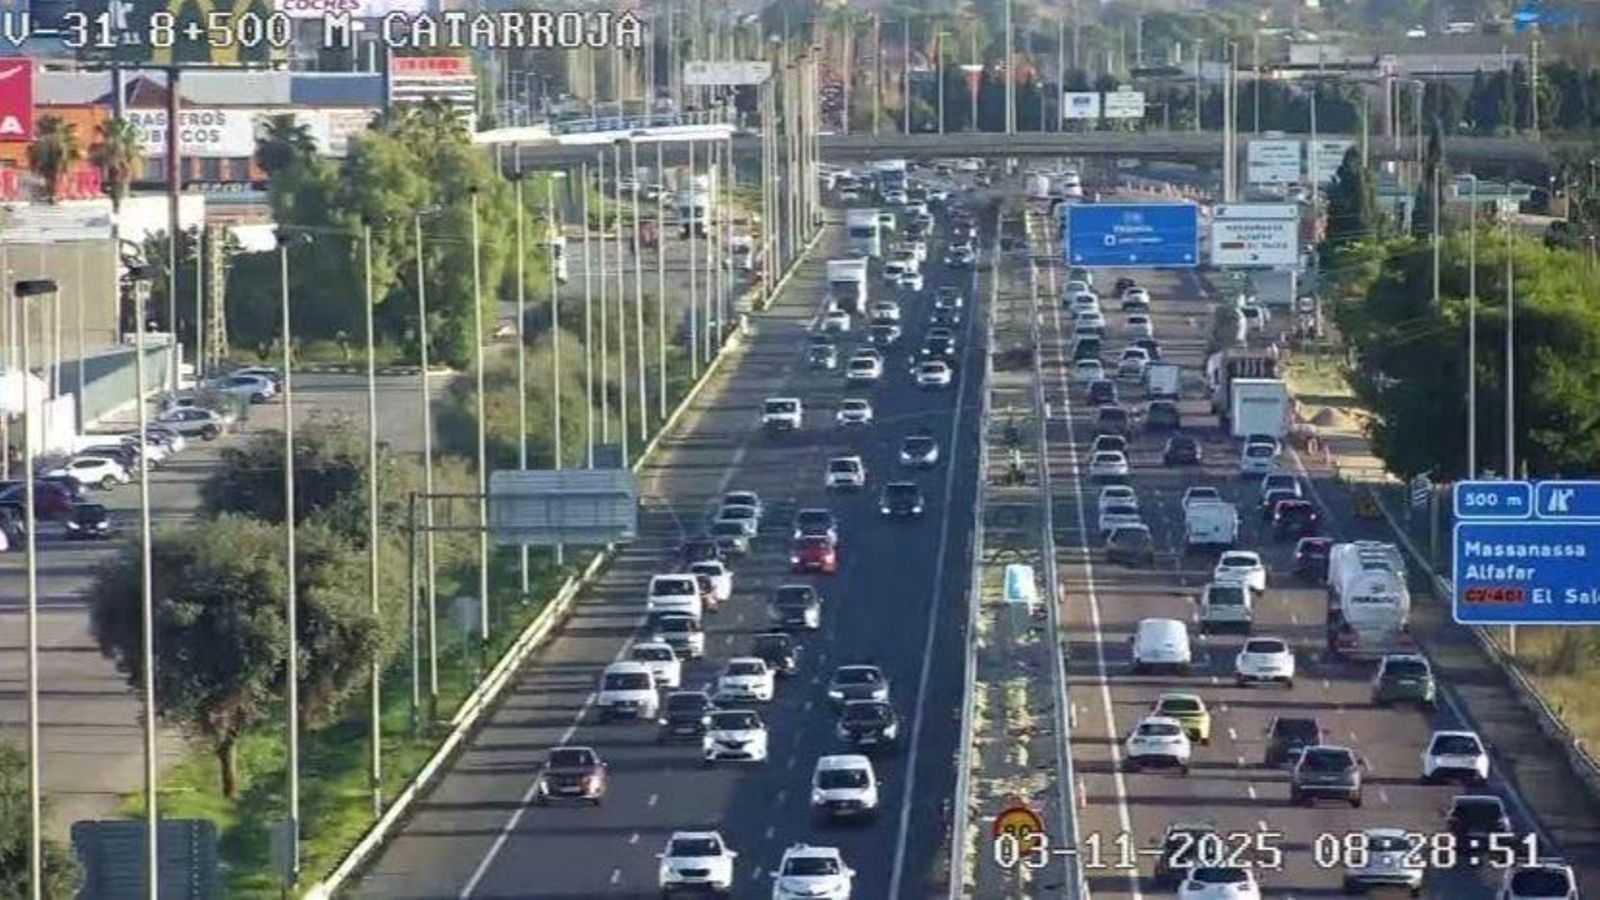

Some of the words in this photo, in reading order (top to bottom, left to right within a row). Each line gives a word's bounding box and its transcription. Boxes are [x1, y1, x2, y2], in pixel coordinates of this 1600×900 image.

[1465, 492, 1498, 506] 500
[1464, 541, 1586, 557] Massanassa
[1465, 564, 1536, 580] Alfafar
[1532, 588, 1552, 604] El
[1565, 588, 1600, 604] Sal
